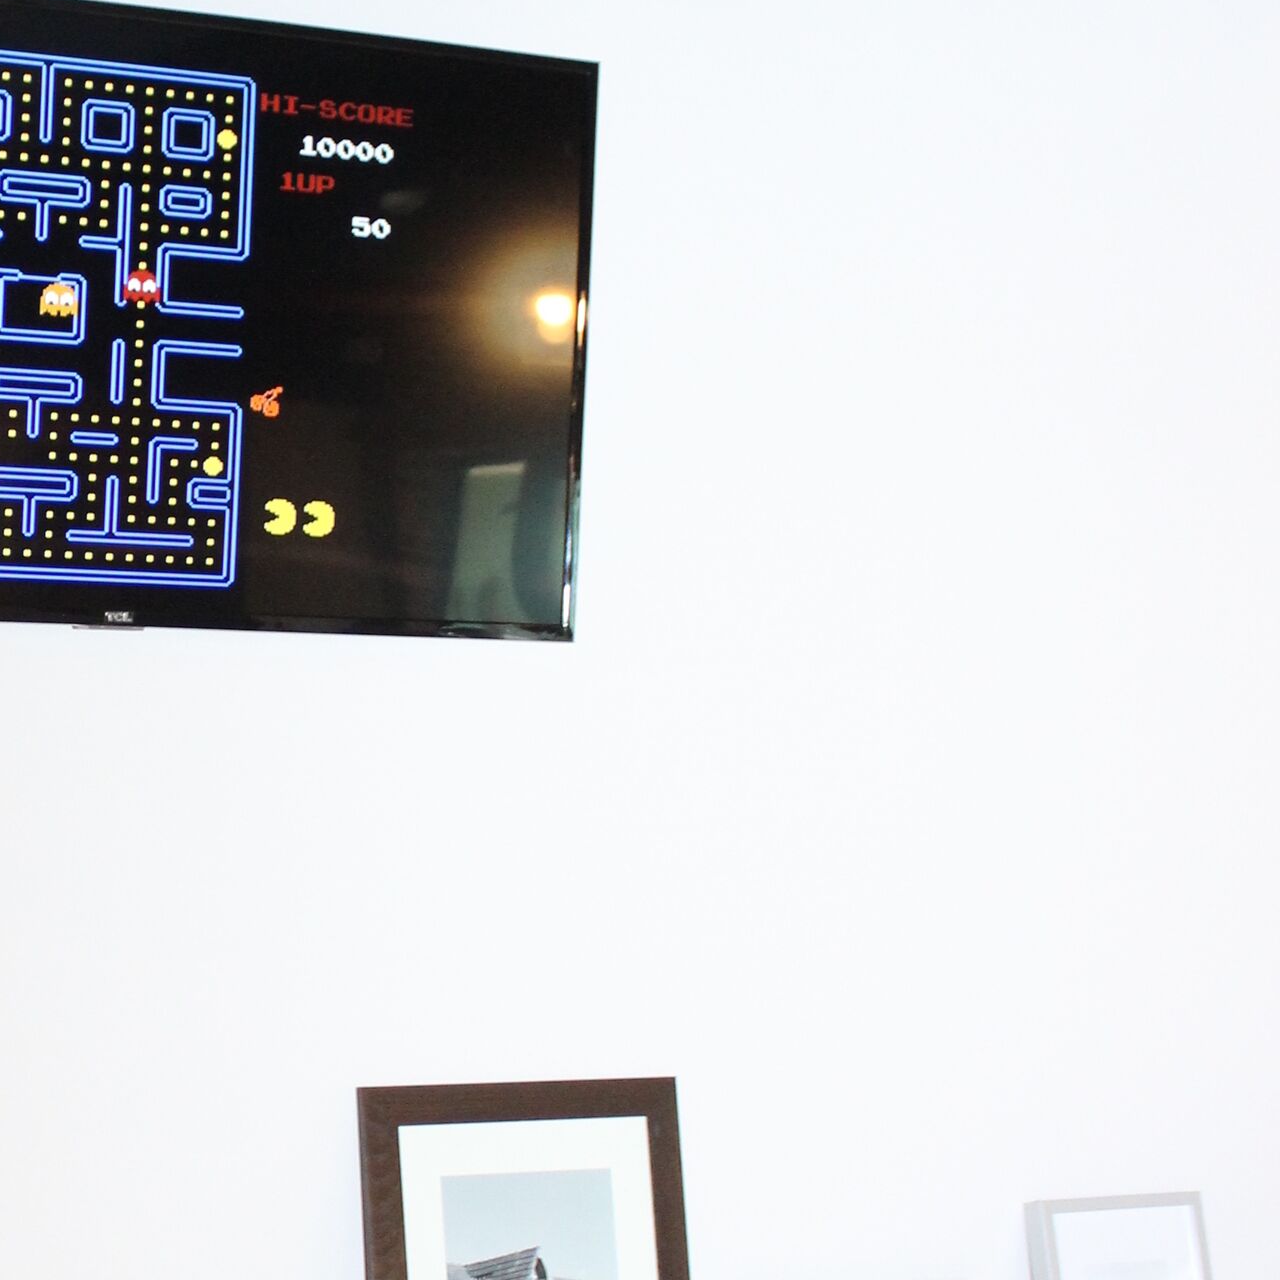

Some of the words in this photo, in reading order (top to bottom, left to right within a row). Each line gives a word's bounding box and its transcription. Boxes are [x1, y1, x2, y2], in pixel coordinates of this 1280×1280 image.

[260, 92, 414, 128] HI-SCORE
[299, 135, 394, 164] 10000
[279, 171, 336, 194] 1UP
[351, 216, 392, 239] 50
[104, 611, 134, 623] TCL
